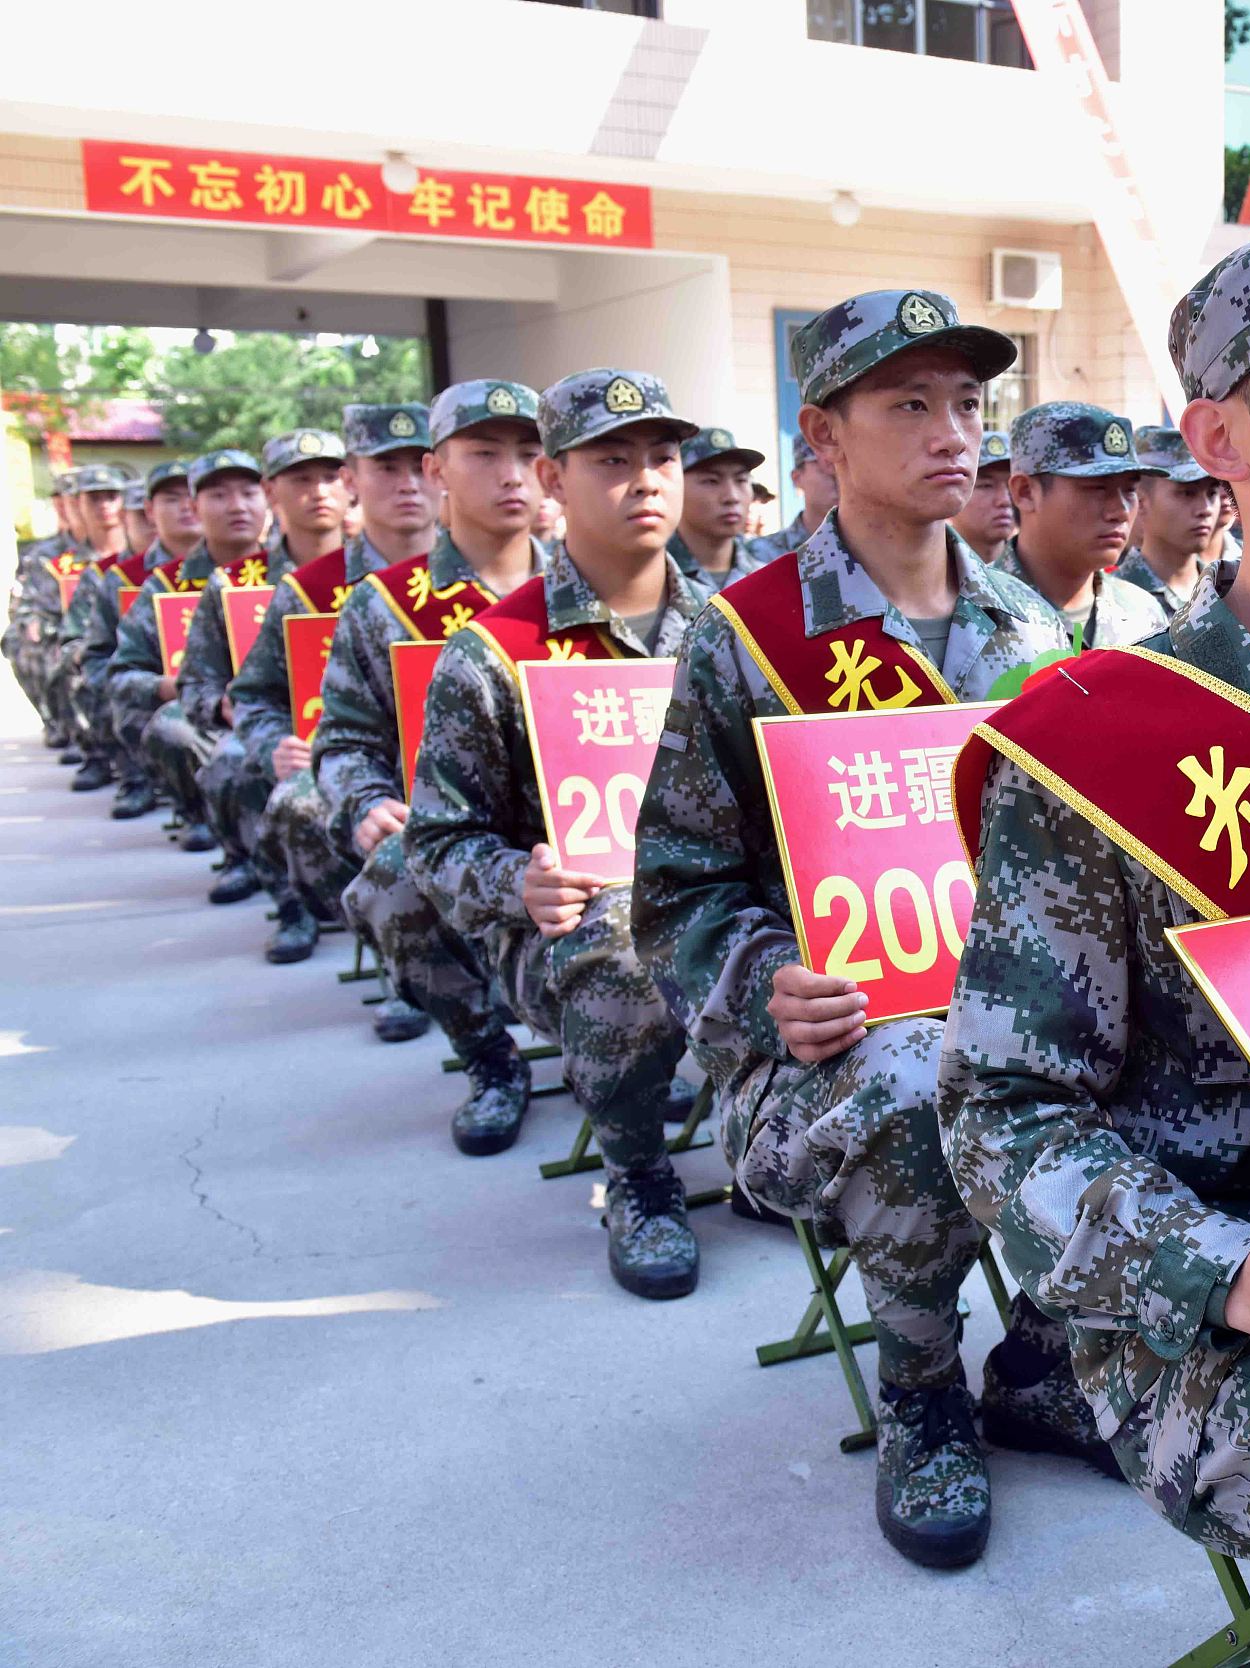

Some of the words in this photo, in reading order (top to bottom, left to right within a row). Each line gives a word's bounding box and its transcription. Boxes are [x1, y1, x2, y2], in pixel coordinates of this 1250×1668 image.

[120, 156, 372, 220] 不忘初心
[410, 183, 625, 239] 牢记使命
[824, 639, 923, 712] 光
[828, 746, 955, 831] 进疆
